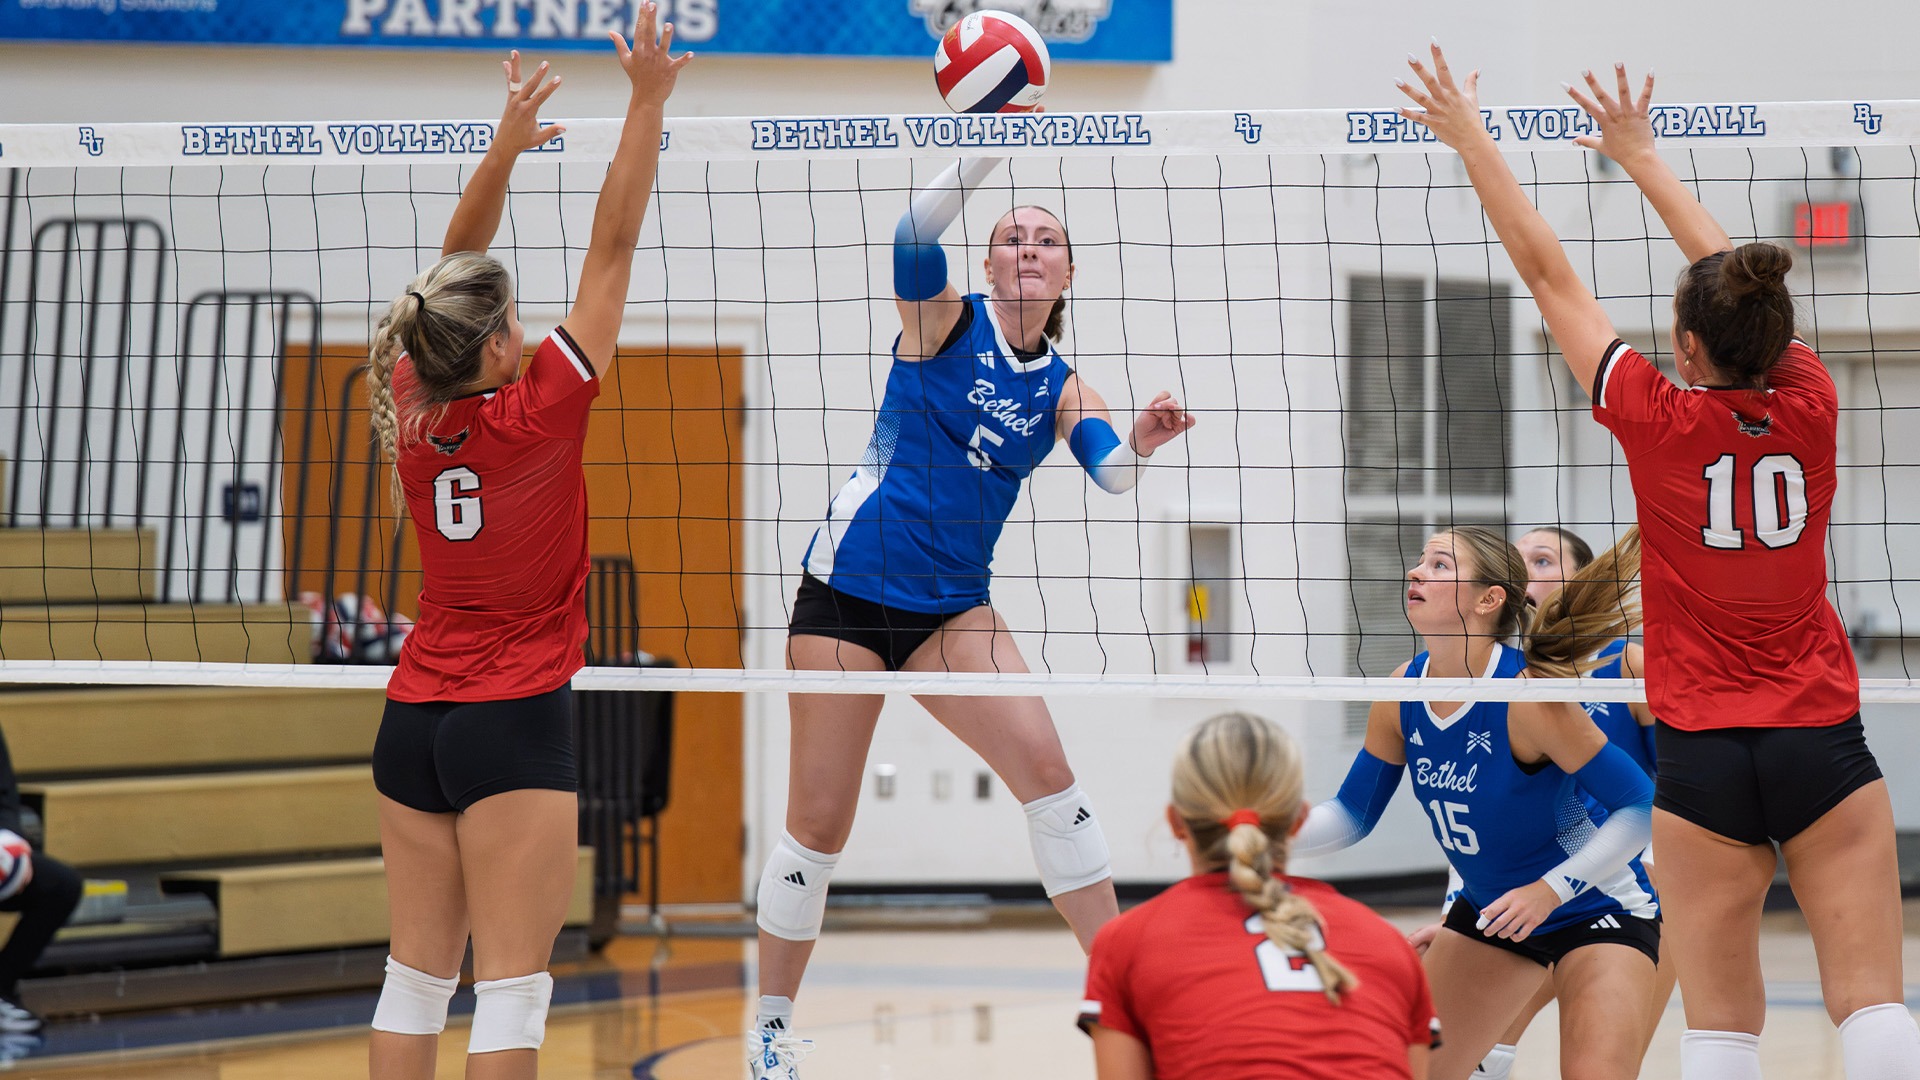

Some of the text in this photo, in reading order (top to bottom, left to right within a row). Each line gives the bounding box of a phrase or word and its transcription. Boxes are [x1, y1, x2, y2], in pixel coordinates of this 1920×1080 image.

[182, 122, 564, 155] BETHEL VOLLEYBL
[751, 115, 1151, 150] BETHEL VOLLEYBALL
[1347, 105, 1766, 142] BETL VOLLBALL
[967, 378, 1043, 436] Bethel
[966, 423, 1004, 471] 5
[433, 464, 484, 541] 6
[1701, 453, 1809, 550] 10
[1416, 757, 1478, 793] Bethel
[1429, 799, 1480, 855] 15
[1244, 912, 1327, 993] 2
